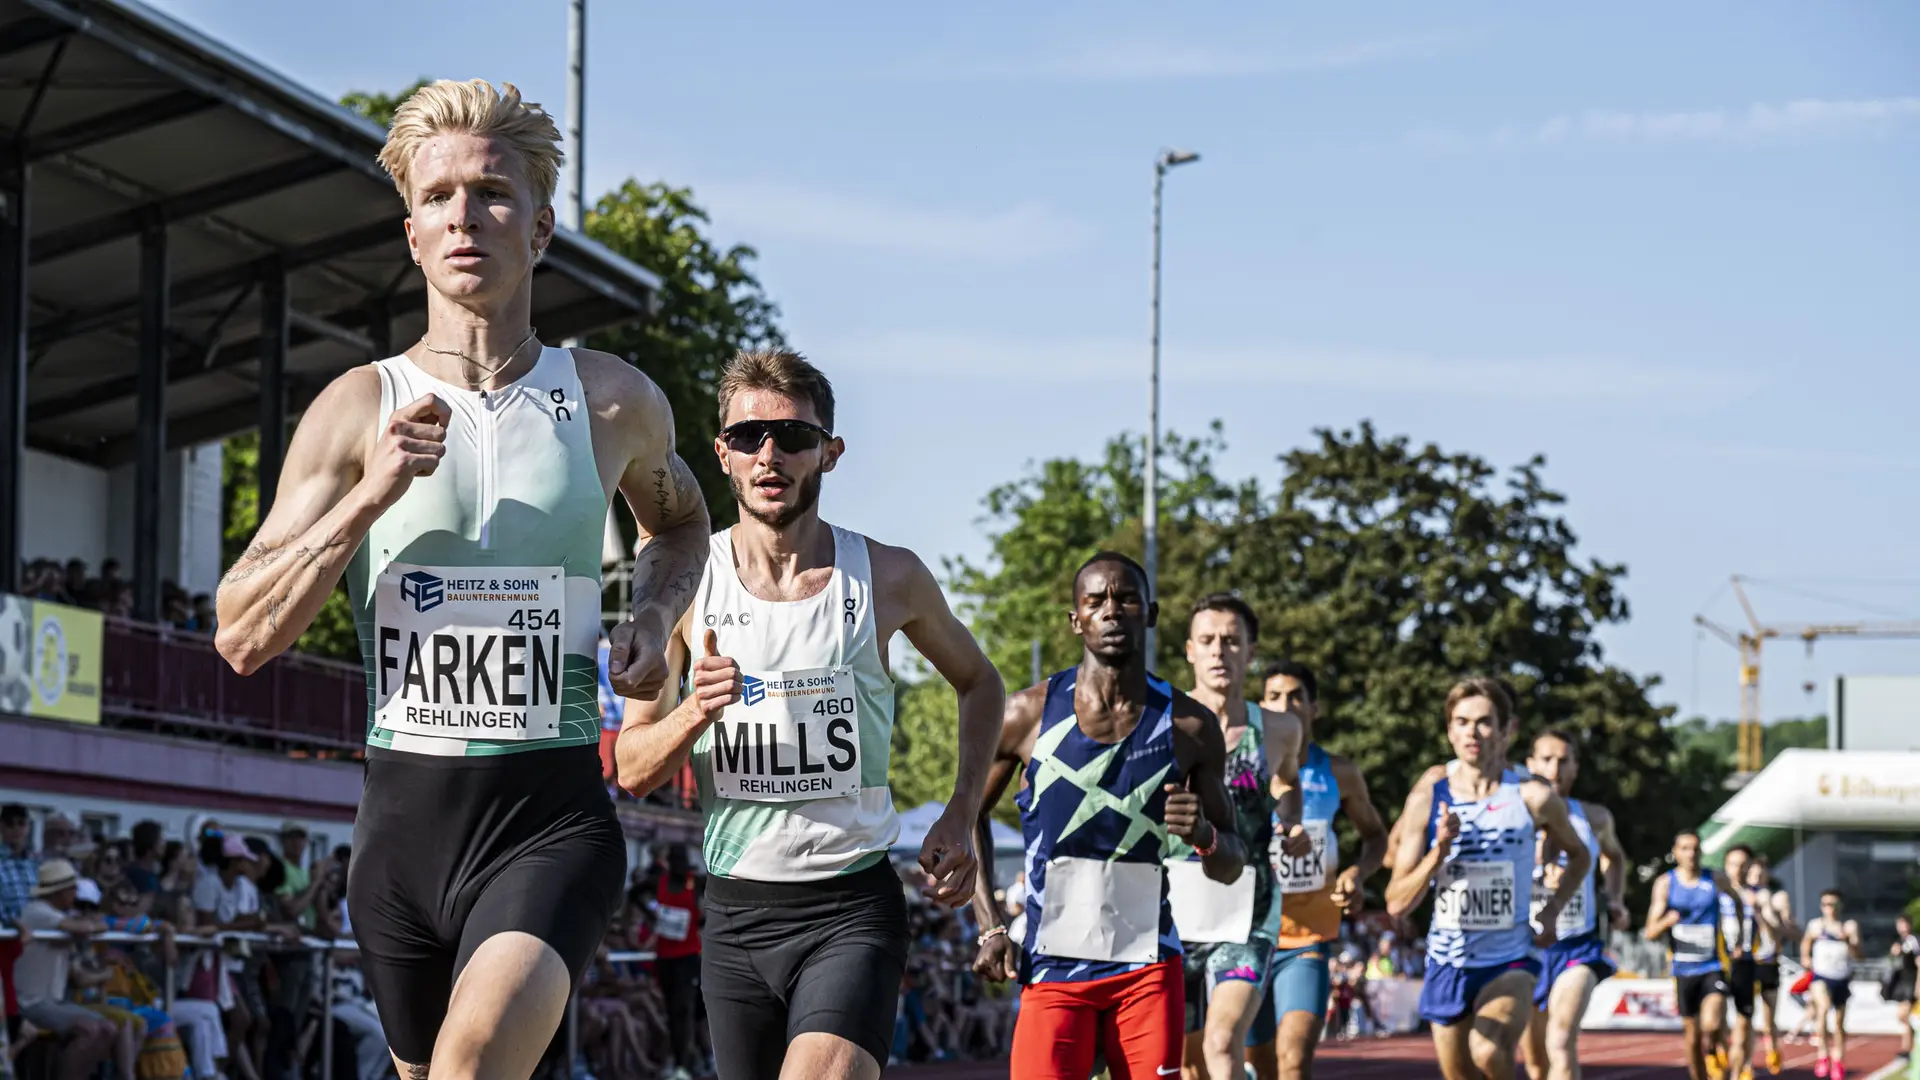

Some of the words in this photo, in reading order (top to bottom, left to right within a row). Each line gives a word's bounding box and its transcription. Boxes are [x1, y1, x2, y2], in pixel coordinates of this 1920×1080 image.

[447, 579, 485, 590] HEITZ
[489, 579, 500, 590] &
[503, 579, 539, 590] SOHN
[447, 593, 540, 602] BAUUNTERNEHMUNG
[508, 609, 561, 631] 454
[380, 625, 560, 707] FARKEN
[767, 679, 795, 690] HEITZ
[797, 678, 805, 688] &
[807, 676, 835, 687] SOHN
[767, 686, 836, 698] BAUUNTERNEHMUNG
[812, 697, 854, 717] 460
[406, 706, 527, 729] REHLINGEN
[714, 718, 857, 776] MILLS
[739, 777, 833, 794] REHLINGEN
[1438, 886, 1513, 916] STONIER
